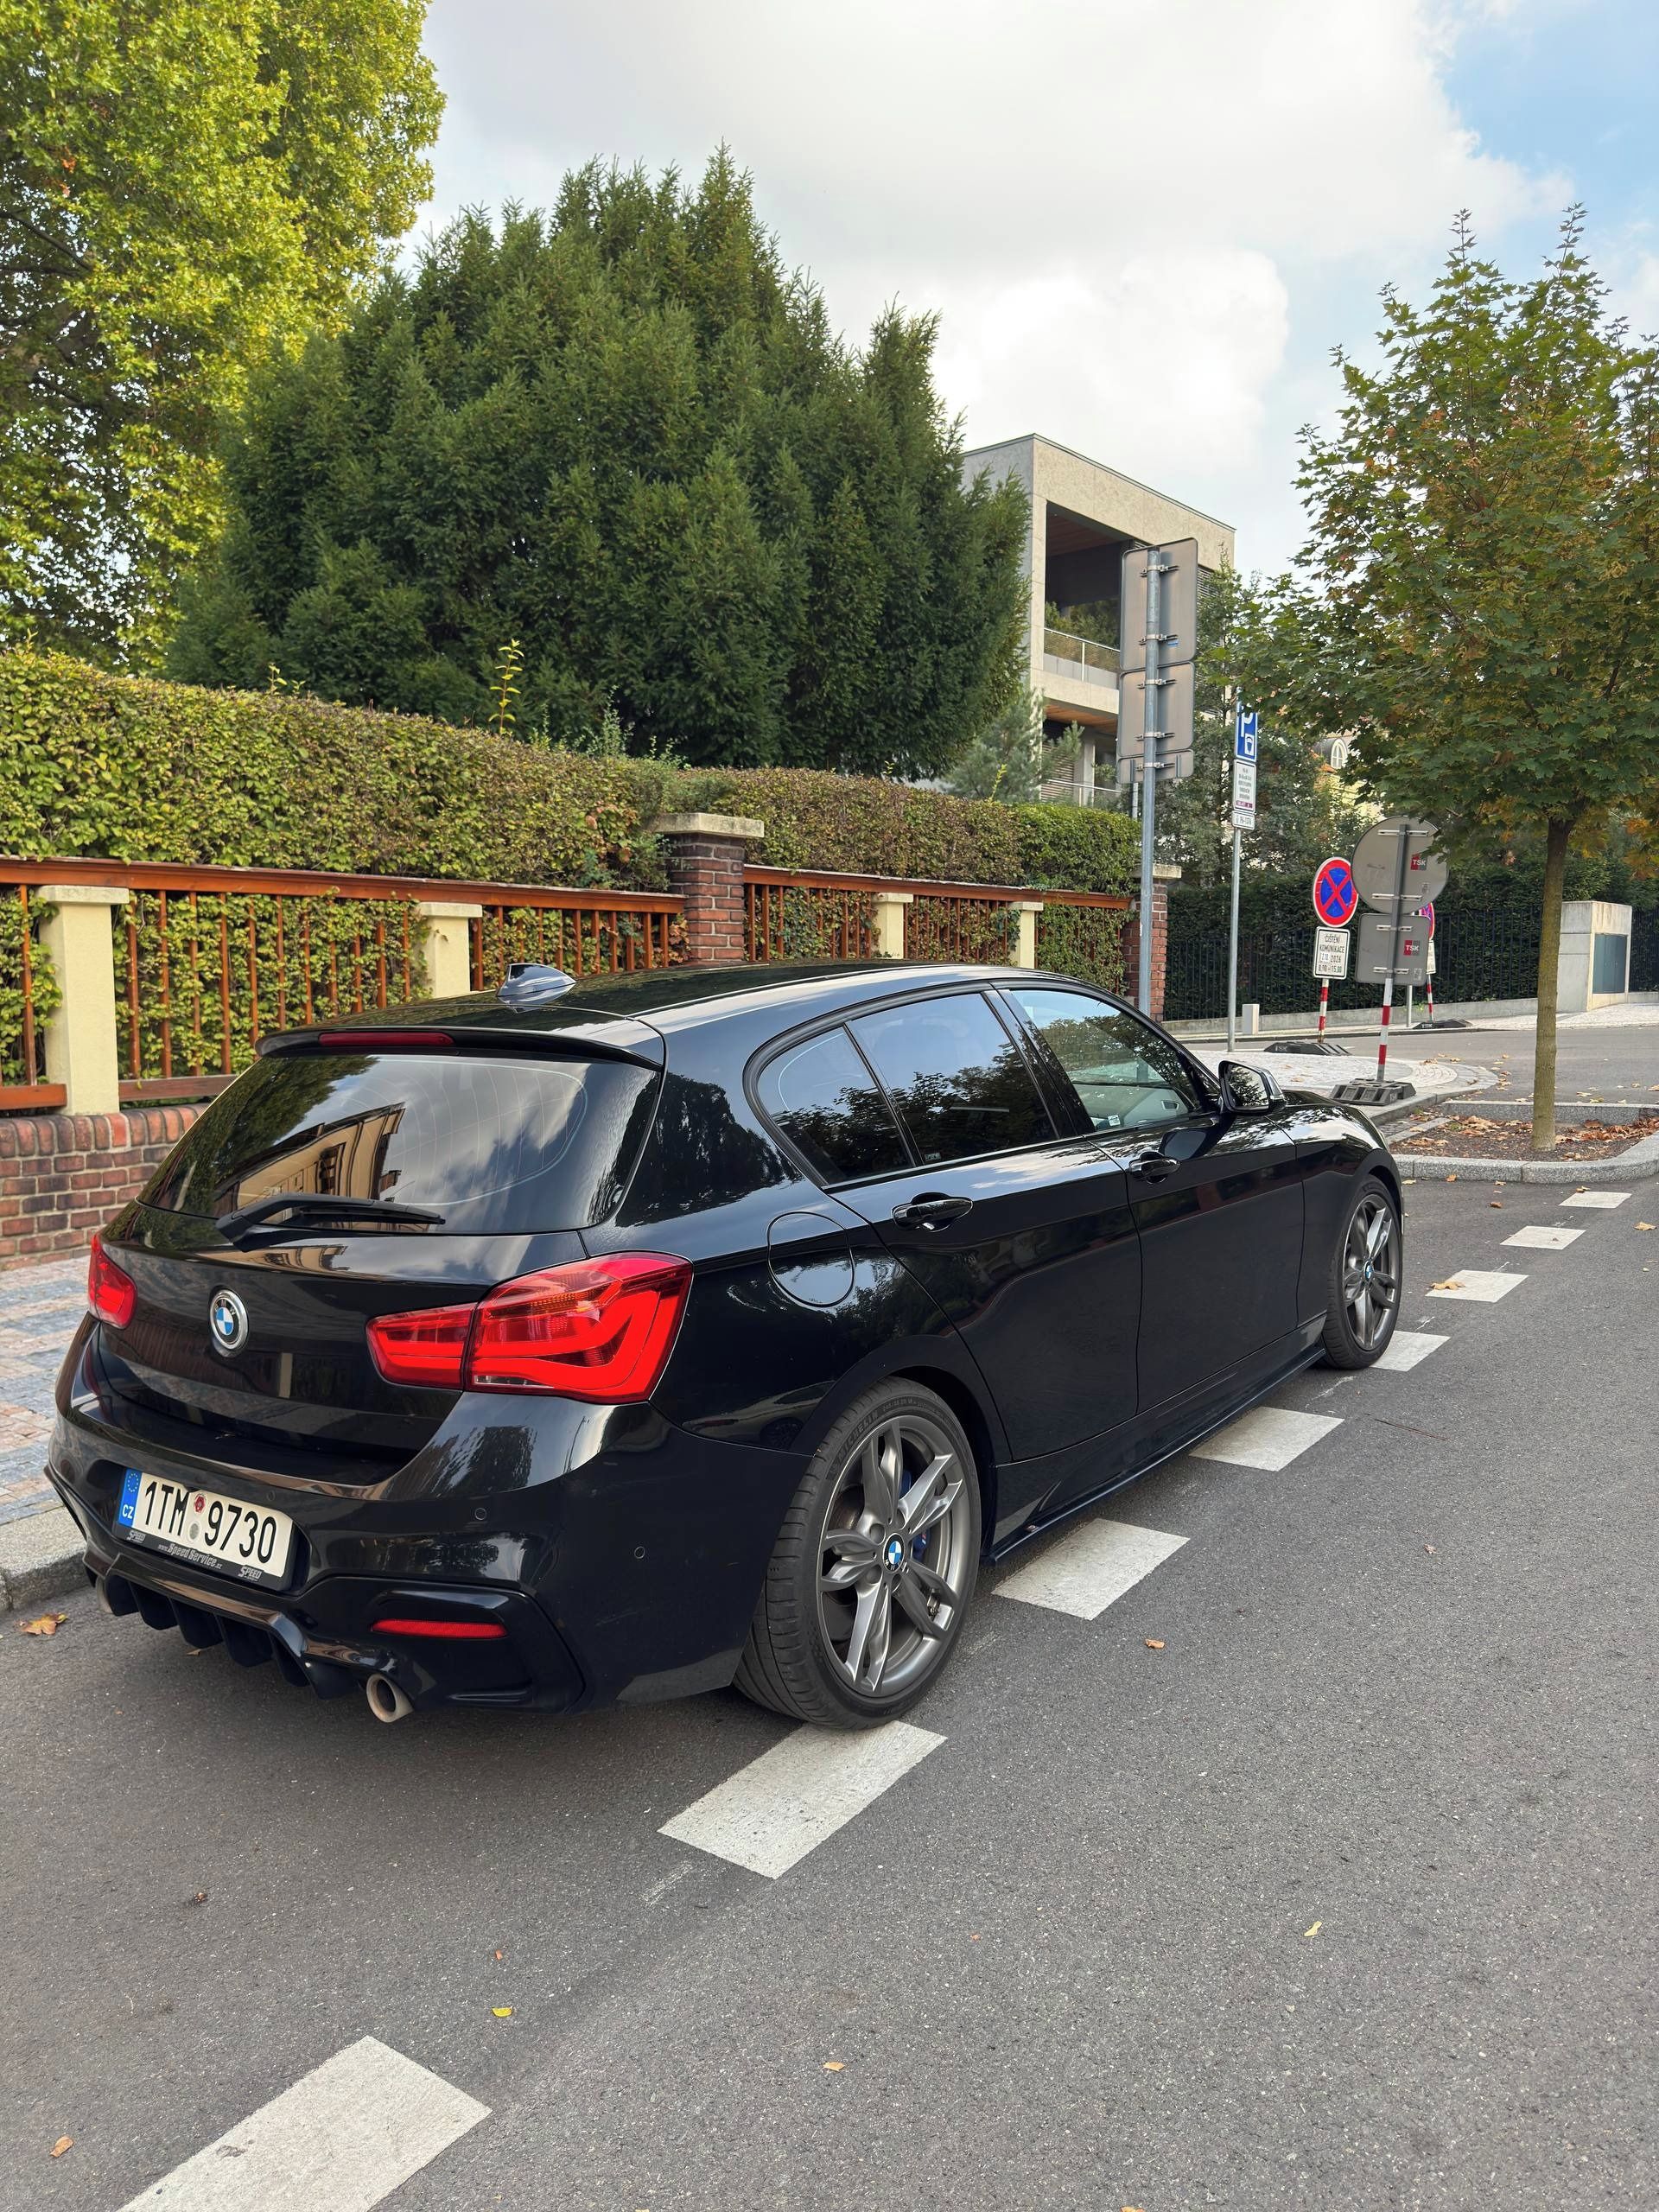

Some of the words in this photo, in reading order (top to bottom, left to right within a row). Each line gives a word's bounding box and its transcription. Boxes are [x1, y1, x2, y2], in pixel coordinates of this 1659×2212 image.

[1319, 944, 1344, 954] KOMUNIKACE
[122, 1504, 134, 1519] CZ
[145, 1481, 190, 1536] 1TM
[204, 1501, 277, 1564] 9730
[126, 1530, 146, 1541] SPEED
[238, 1566, 263, 1579] SPEED
